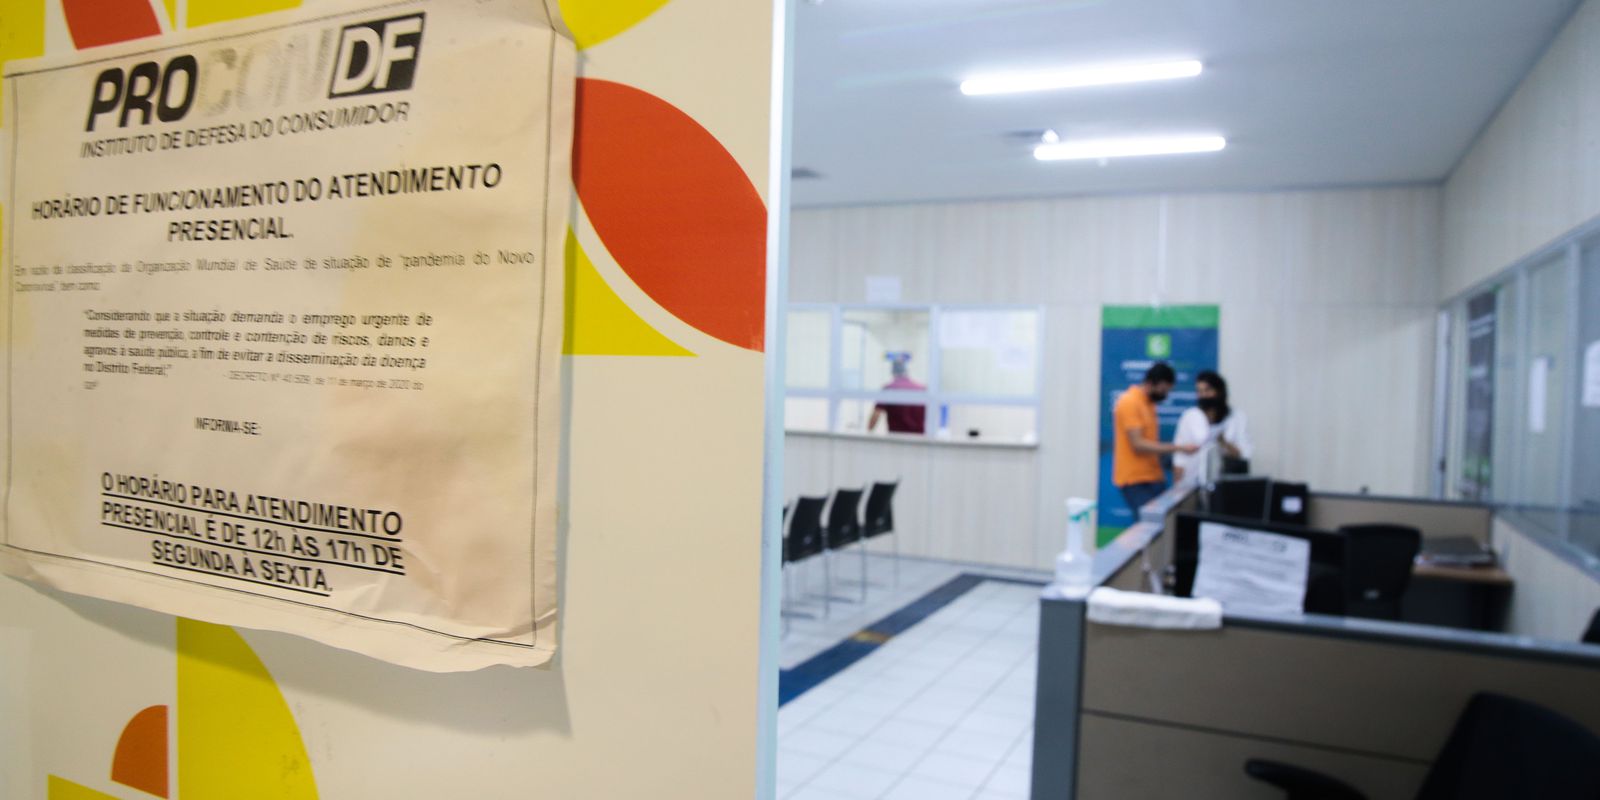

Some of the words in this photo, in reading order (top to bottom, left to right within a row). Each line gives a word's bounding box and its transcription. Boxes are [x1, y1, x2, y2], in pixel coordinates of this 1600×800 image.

[81, 134, 157, 158] INSTITUTO
[160, 131, 182, 150] DE
[185, 123, 246, 148] DEFESA
[250, 118, 273, 139] DO
[278, 102, 410, 136] CONSUMIDOR
[32, 193, 101, 220] HORÁRIO
[105, 195, 128, 216] DE
[132, 181, 289, 213] FUNCIONAMENTO
[294, 177, 322, 202] DO
[328, 163, 502, 199] ATENDIMENTO
[168, 217, 294, 242] PRESENCIAL.
[323, 255, 370, 272] situação
[376, 254, 392, 268] de
[473, 250, 490, 265] do
[498, 249, 535, 265] Novo
[155, 312, 170, 324] que
[183, 309, 226, 323] situação
[231, 310, 284, 324] demanda
[289, 314, 298, 324] o
[303, 313, 356, 328] emprego
[361, 313, 410, 329] urgente
[416, 312, 433, 326] de
[84, 328, 120, 339] medidas
[124, 328, 136, 339] de
[189, 328, 230, 341] controle
[234, 331, 241, 341] e
[245, 330, 307, 345] contenção
[312, 331, 328, 345] de
[332, 333, 373, 348] riscos,
[377, 333, 416, 347] danos
[420, 335, 430, 347] e
[84, 346, 117, 357] agravos
[216, 349, 229, 360] de
[232, 349, 266, 362] evitar
[267, 352, 274, 362] a
[276, 350, 359, 368] disseminação
[361, 352, 377, 367] da
[379, 354, 427, 371] doença
[84, 362, 94, 372] no
[96, 361, 129, 374] Distrito
[101, 472, 114, 491] O
[116, 474, 187, 503] HORÁRIO
[191, 485, 241, 513] PARA
[245, 494, 402, 535] ATENDIMENTO
[101, 501, 201, 537] PRESENCIAL
[206, 514, 217, 541] É
[222, 521, 247, 546] DE
[252, 527, 286, 551] 12h
[292, 528, 320, 557] ÀS
[327, 538, 366, 563] 17h
[372, 543, 405, 570] DE
[151, 539, 239, 574] SEGUNDA
[243, 551, 257, 577] À
[260, 559, 333, 592] SEXTA.
